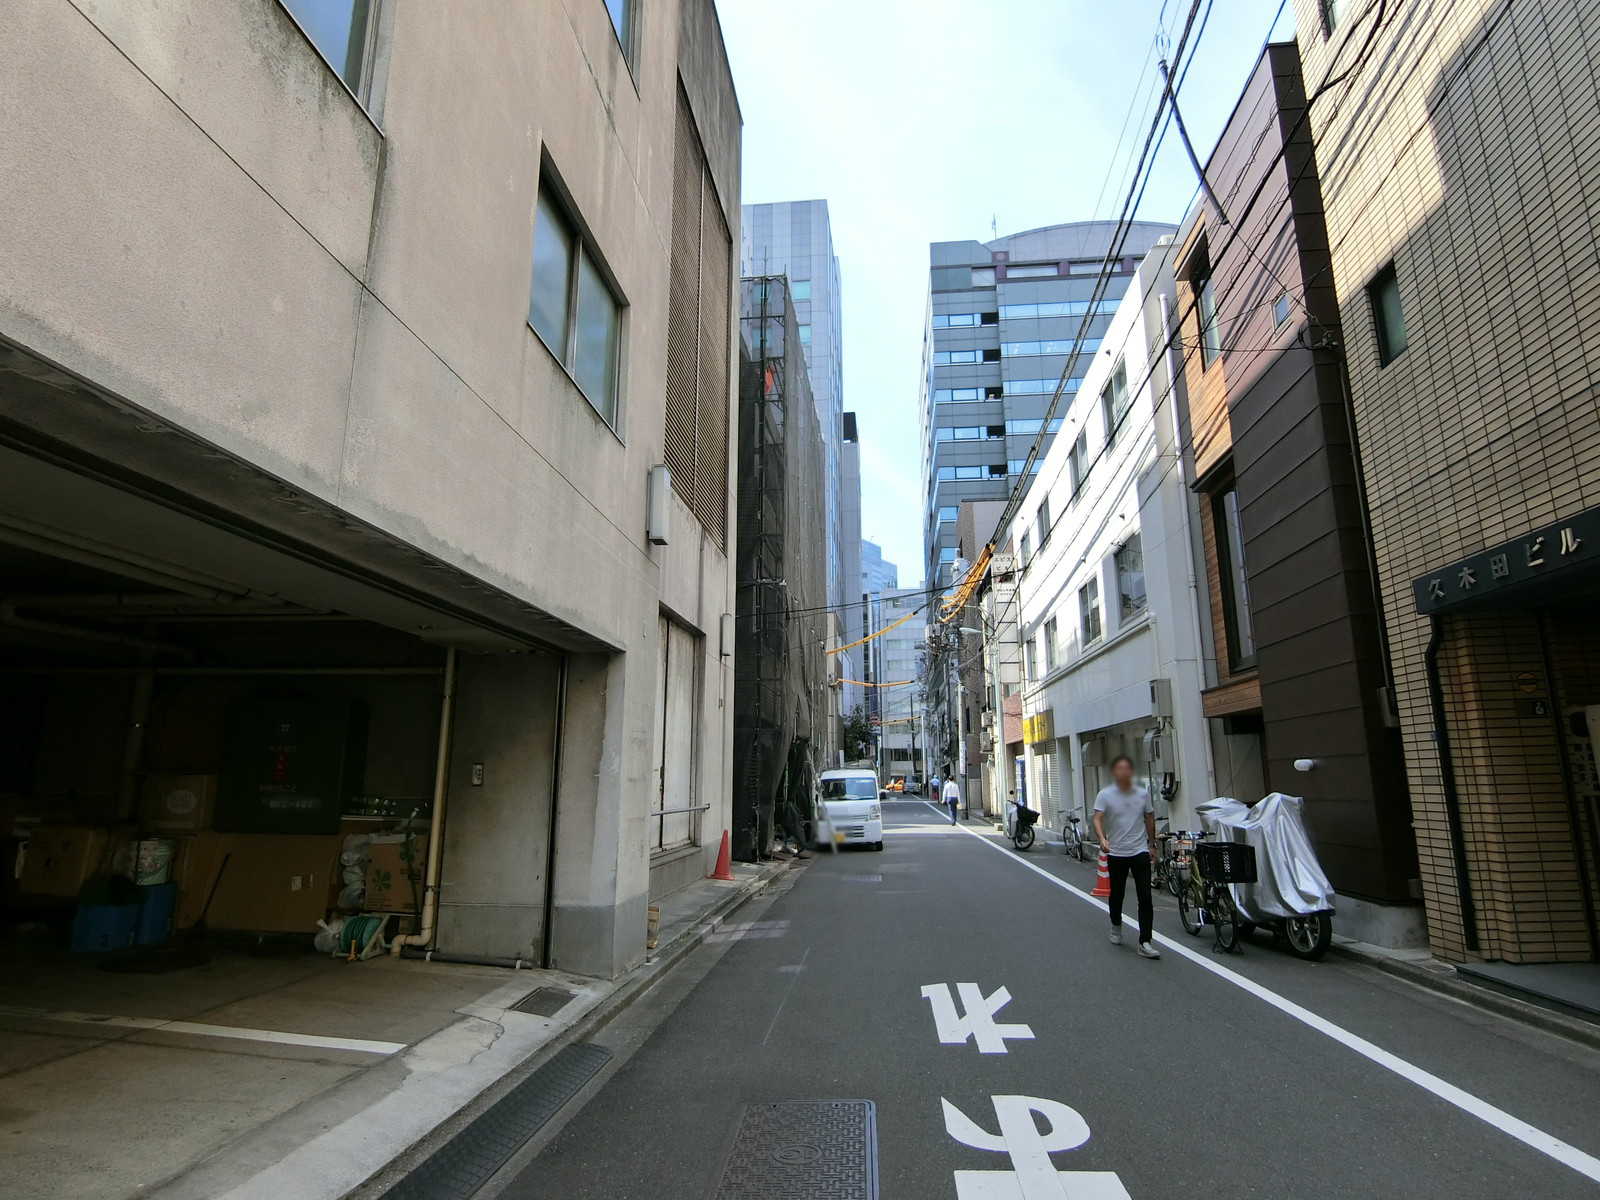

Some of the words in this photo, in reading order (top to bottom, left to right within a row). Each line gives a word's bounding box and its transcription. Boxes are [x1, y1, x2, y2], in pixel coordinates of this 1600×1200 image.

[1428, 527, 1582, 600] 久木田ビル
